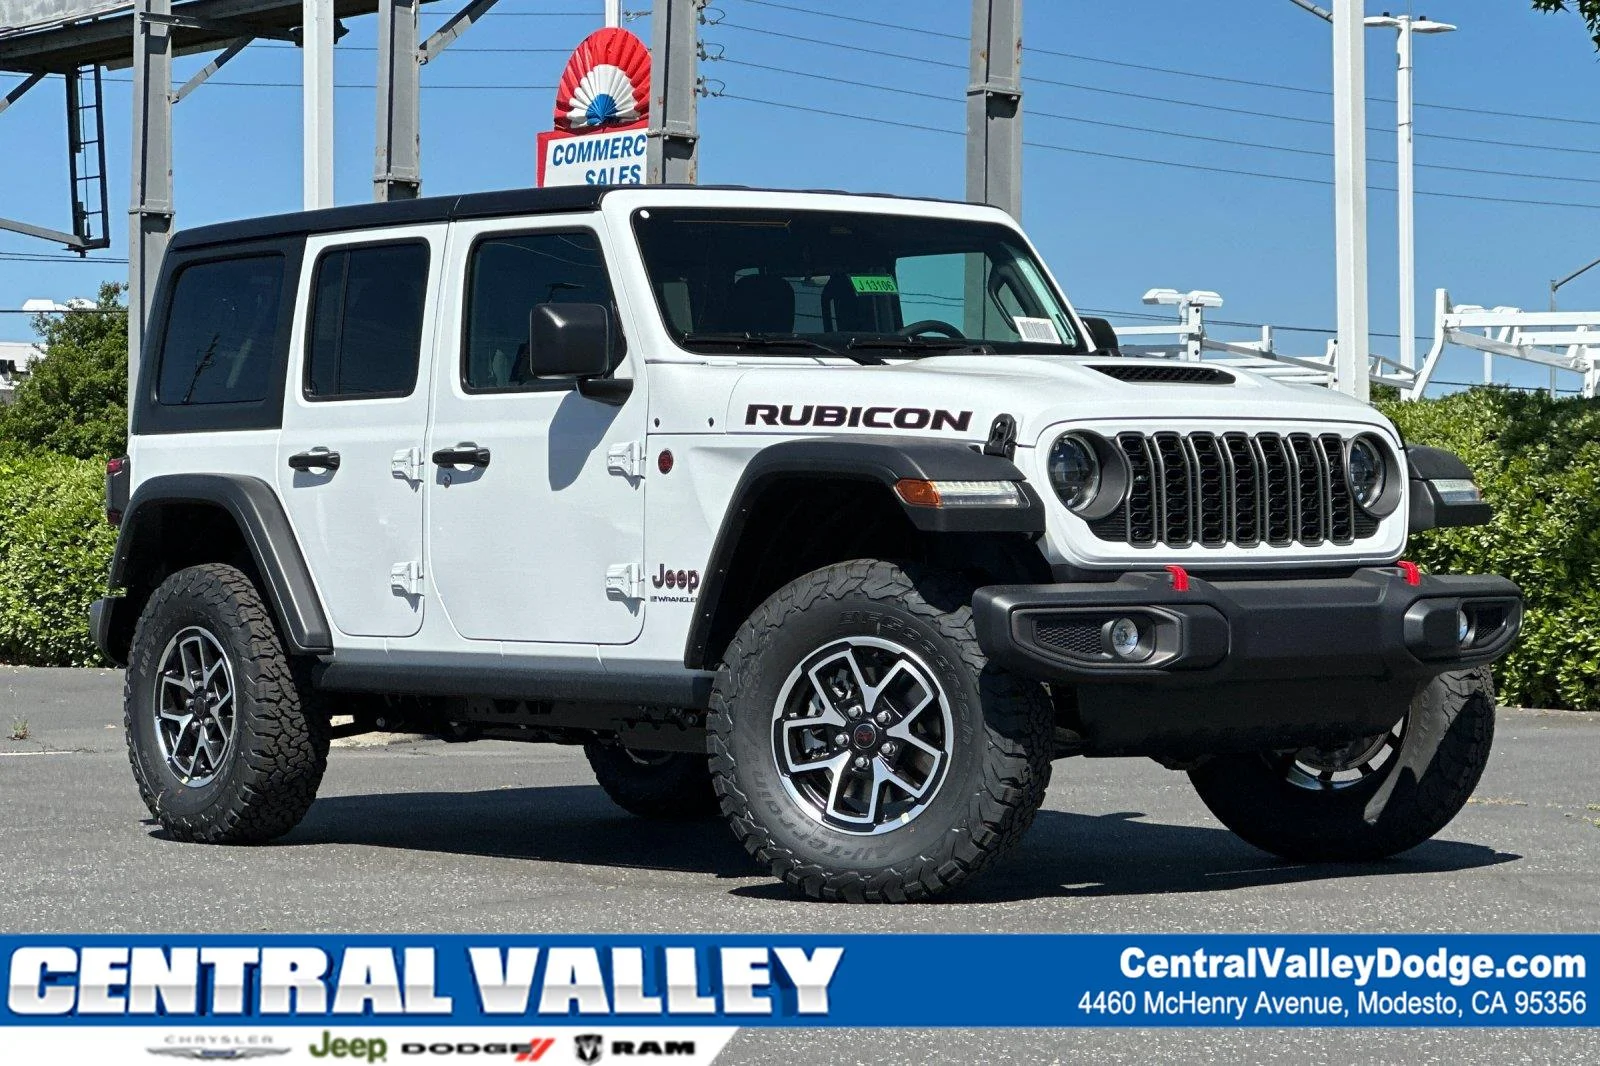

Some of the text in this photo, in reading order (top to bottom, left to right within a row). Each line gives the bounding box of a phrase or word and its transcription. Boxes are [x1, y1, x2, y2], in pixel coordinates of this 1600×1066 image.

[585, 164, 642, 185] SALES
[744, 403, 974, 432] RUBICON
[652, 563, 699, 594] Jeep
